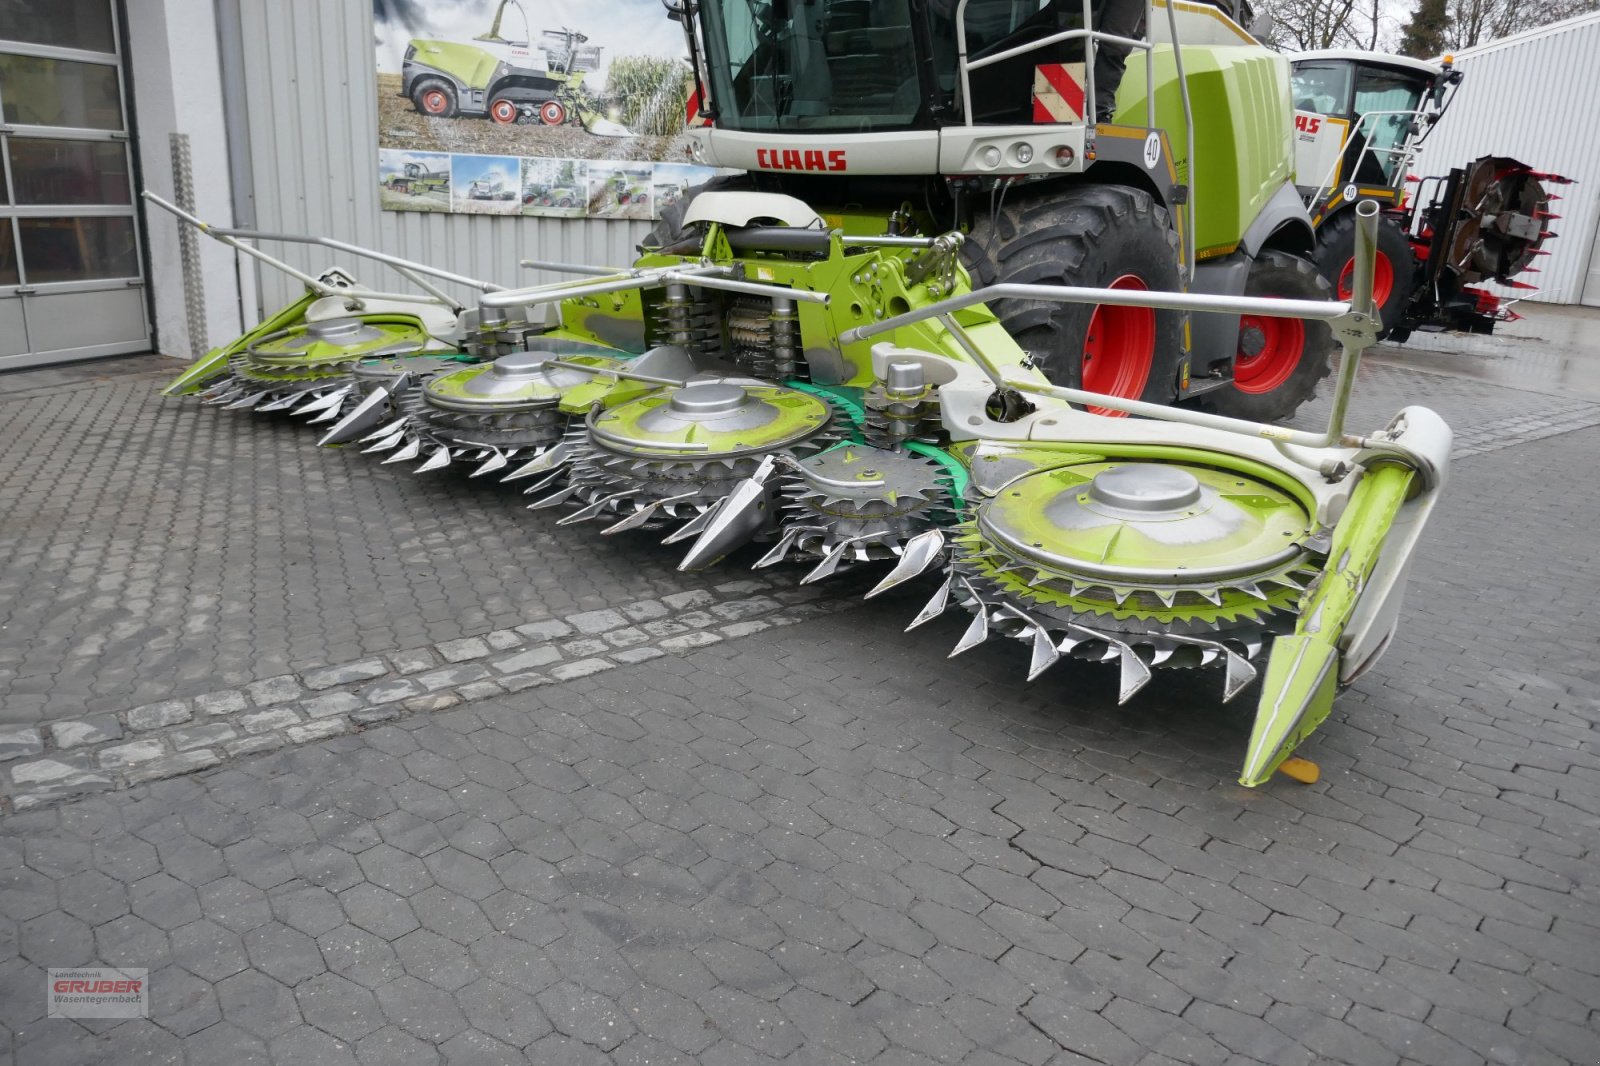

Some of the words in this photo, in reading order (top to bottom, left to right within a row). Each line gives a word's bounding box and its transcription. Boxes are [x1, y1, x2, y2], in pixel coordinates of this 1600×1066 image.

[757, 149, 847, 171] CLAAS
[1146, 138, 1158, 161] 40
[1345, 186, 1355, 198] 40
